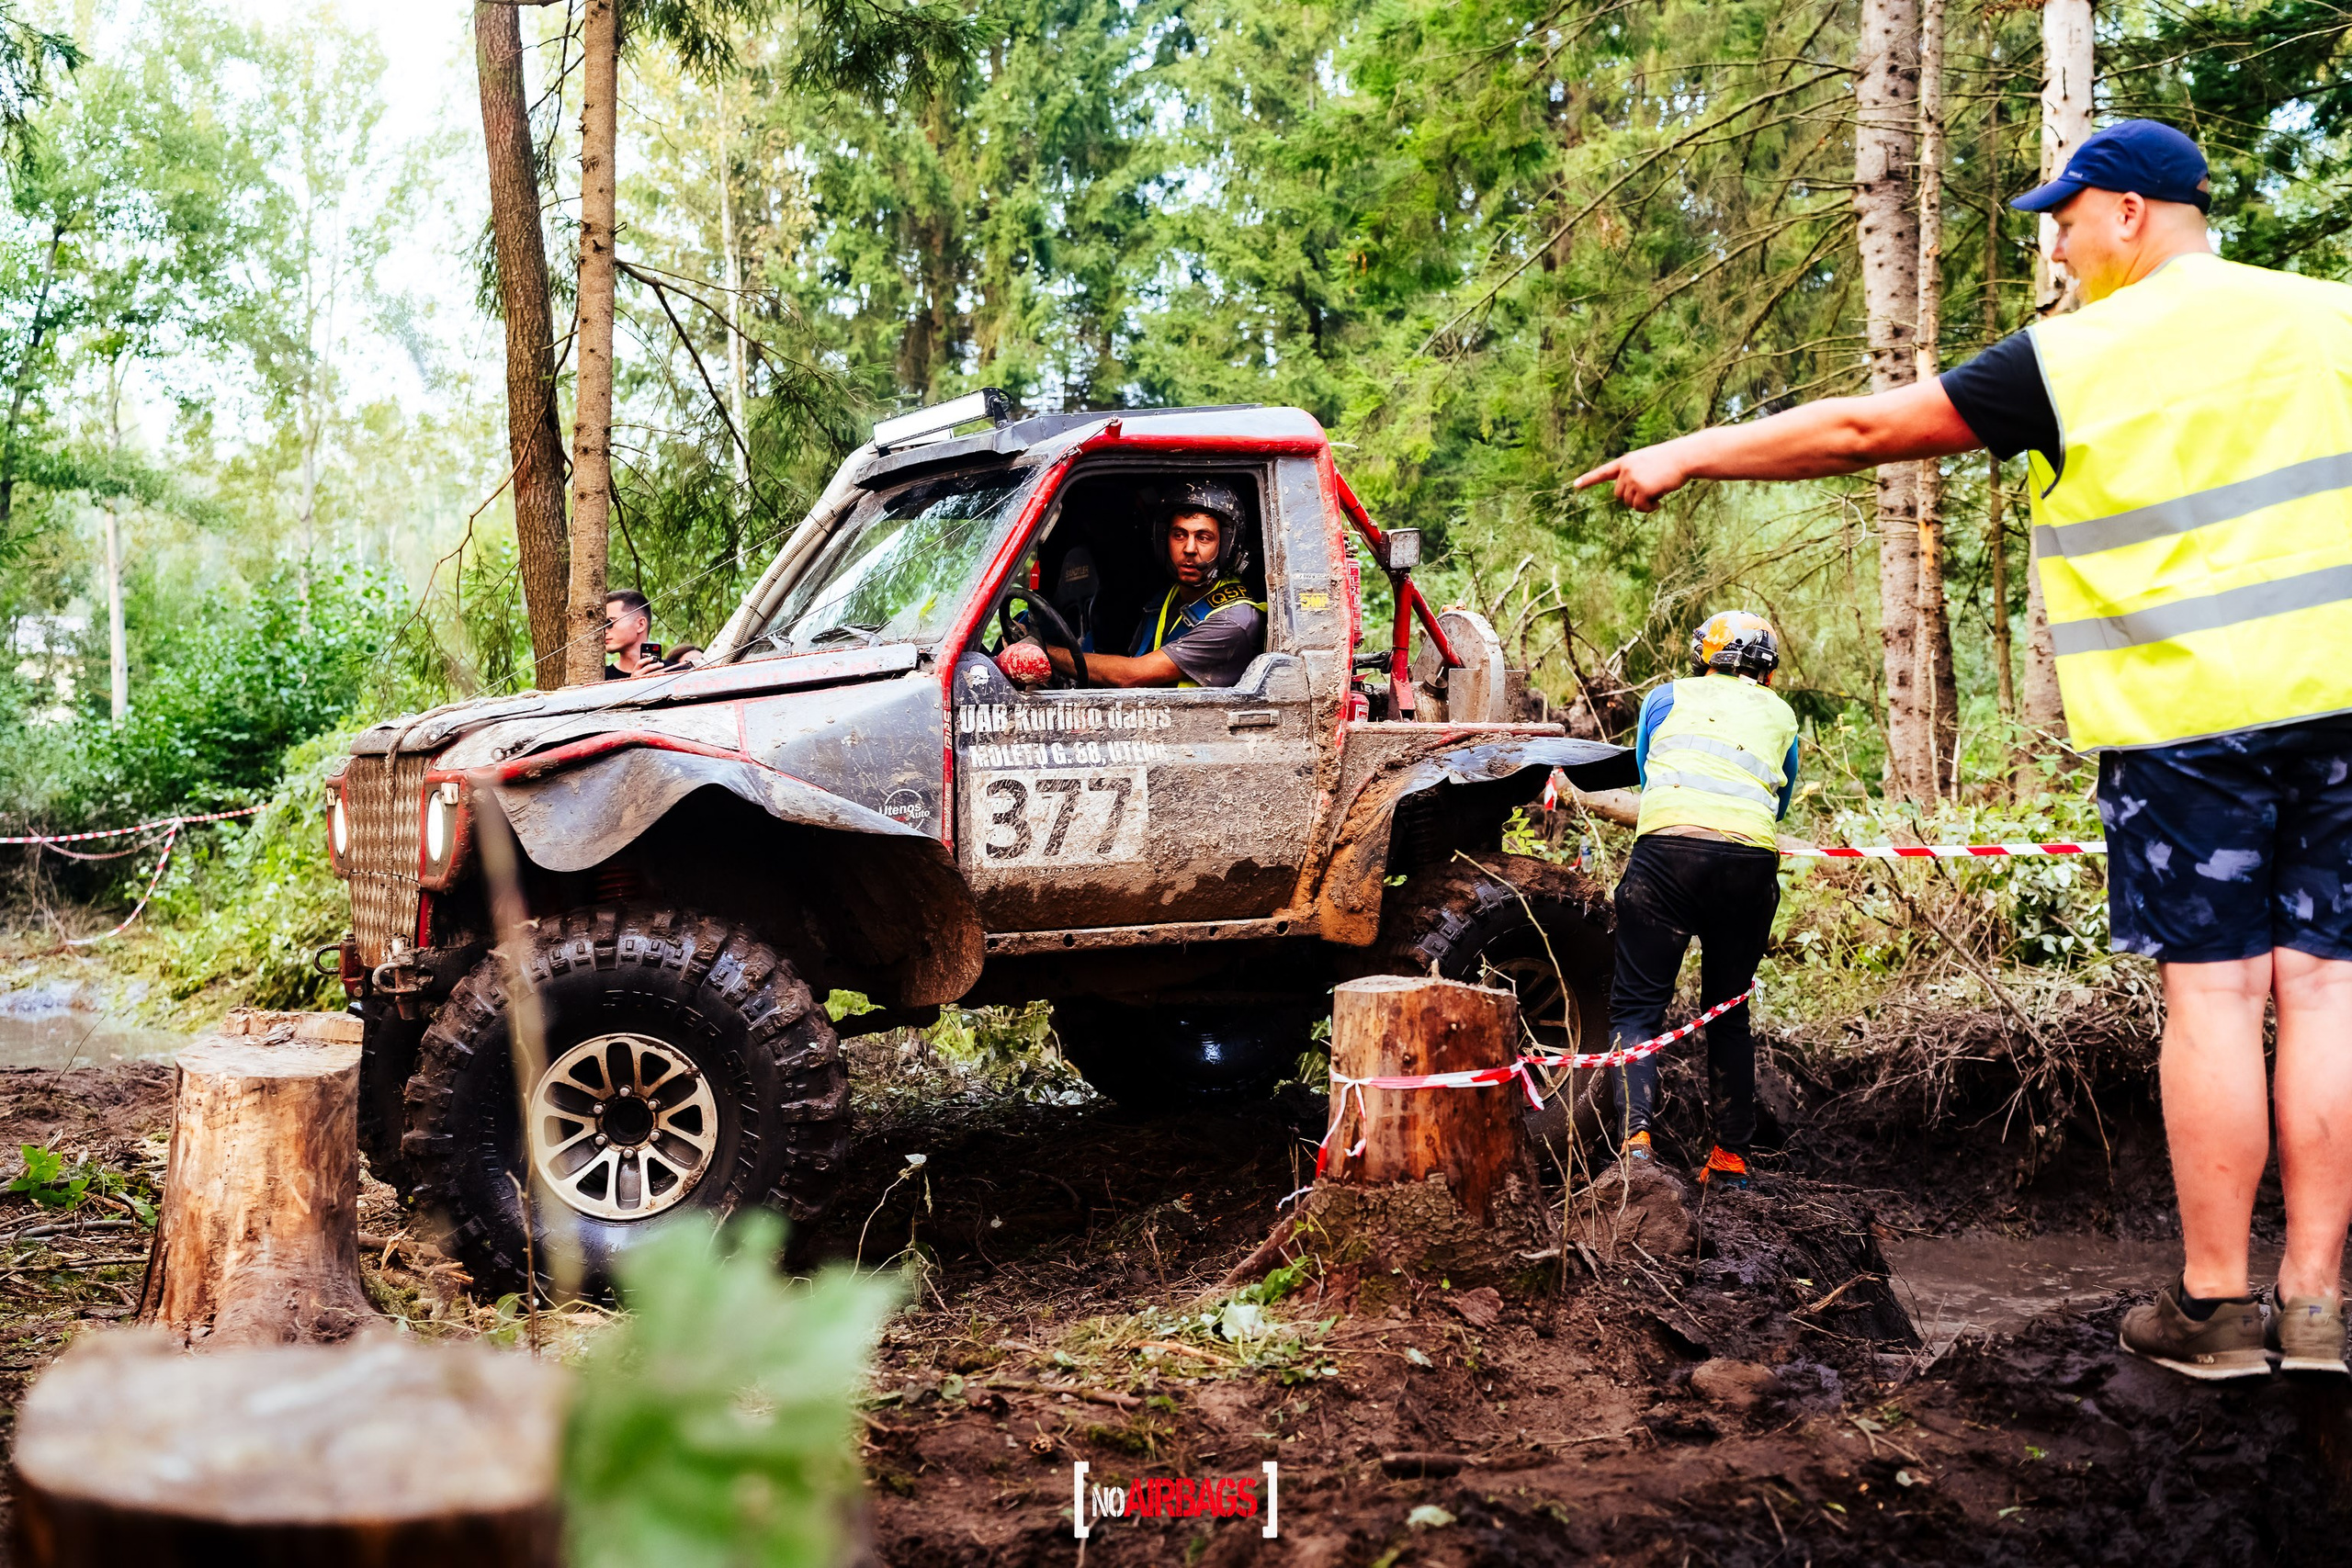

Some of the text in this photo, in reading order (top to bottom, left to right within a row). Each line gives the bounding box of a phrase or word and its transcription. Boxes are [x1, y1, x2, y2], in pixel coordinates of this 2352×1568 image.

[1212, 585, 1248, 604] QSP
[958, 703, 1009, 734] UAB
[1050, 741, 1073, 765] G.
[878, 803, 922, 817] Utenos
[910, 808, 931, 819] Auto
[986, 777, 1133, 860] 377
